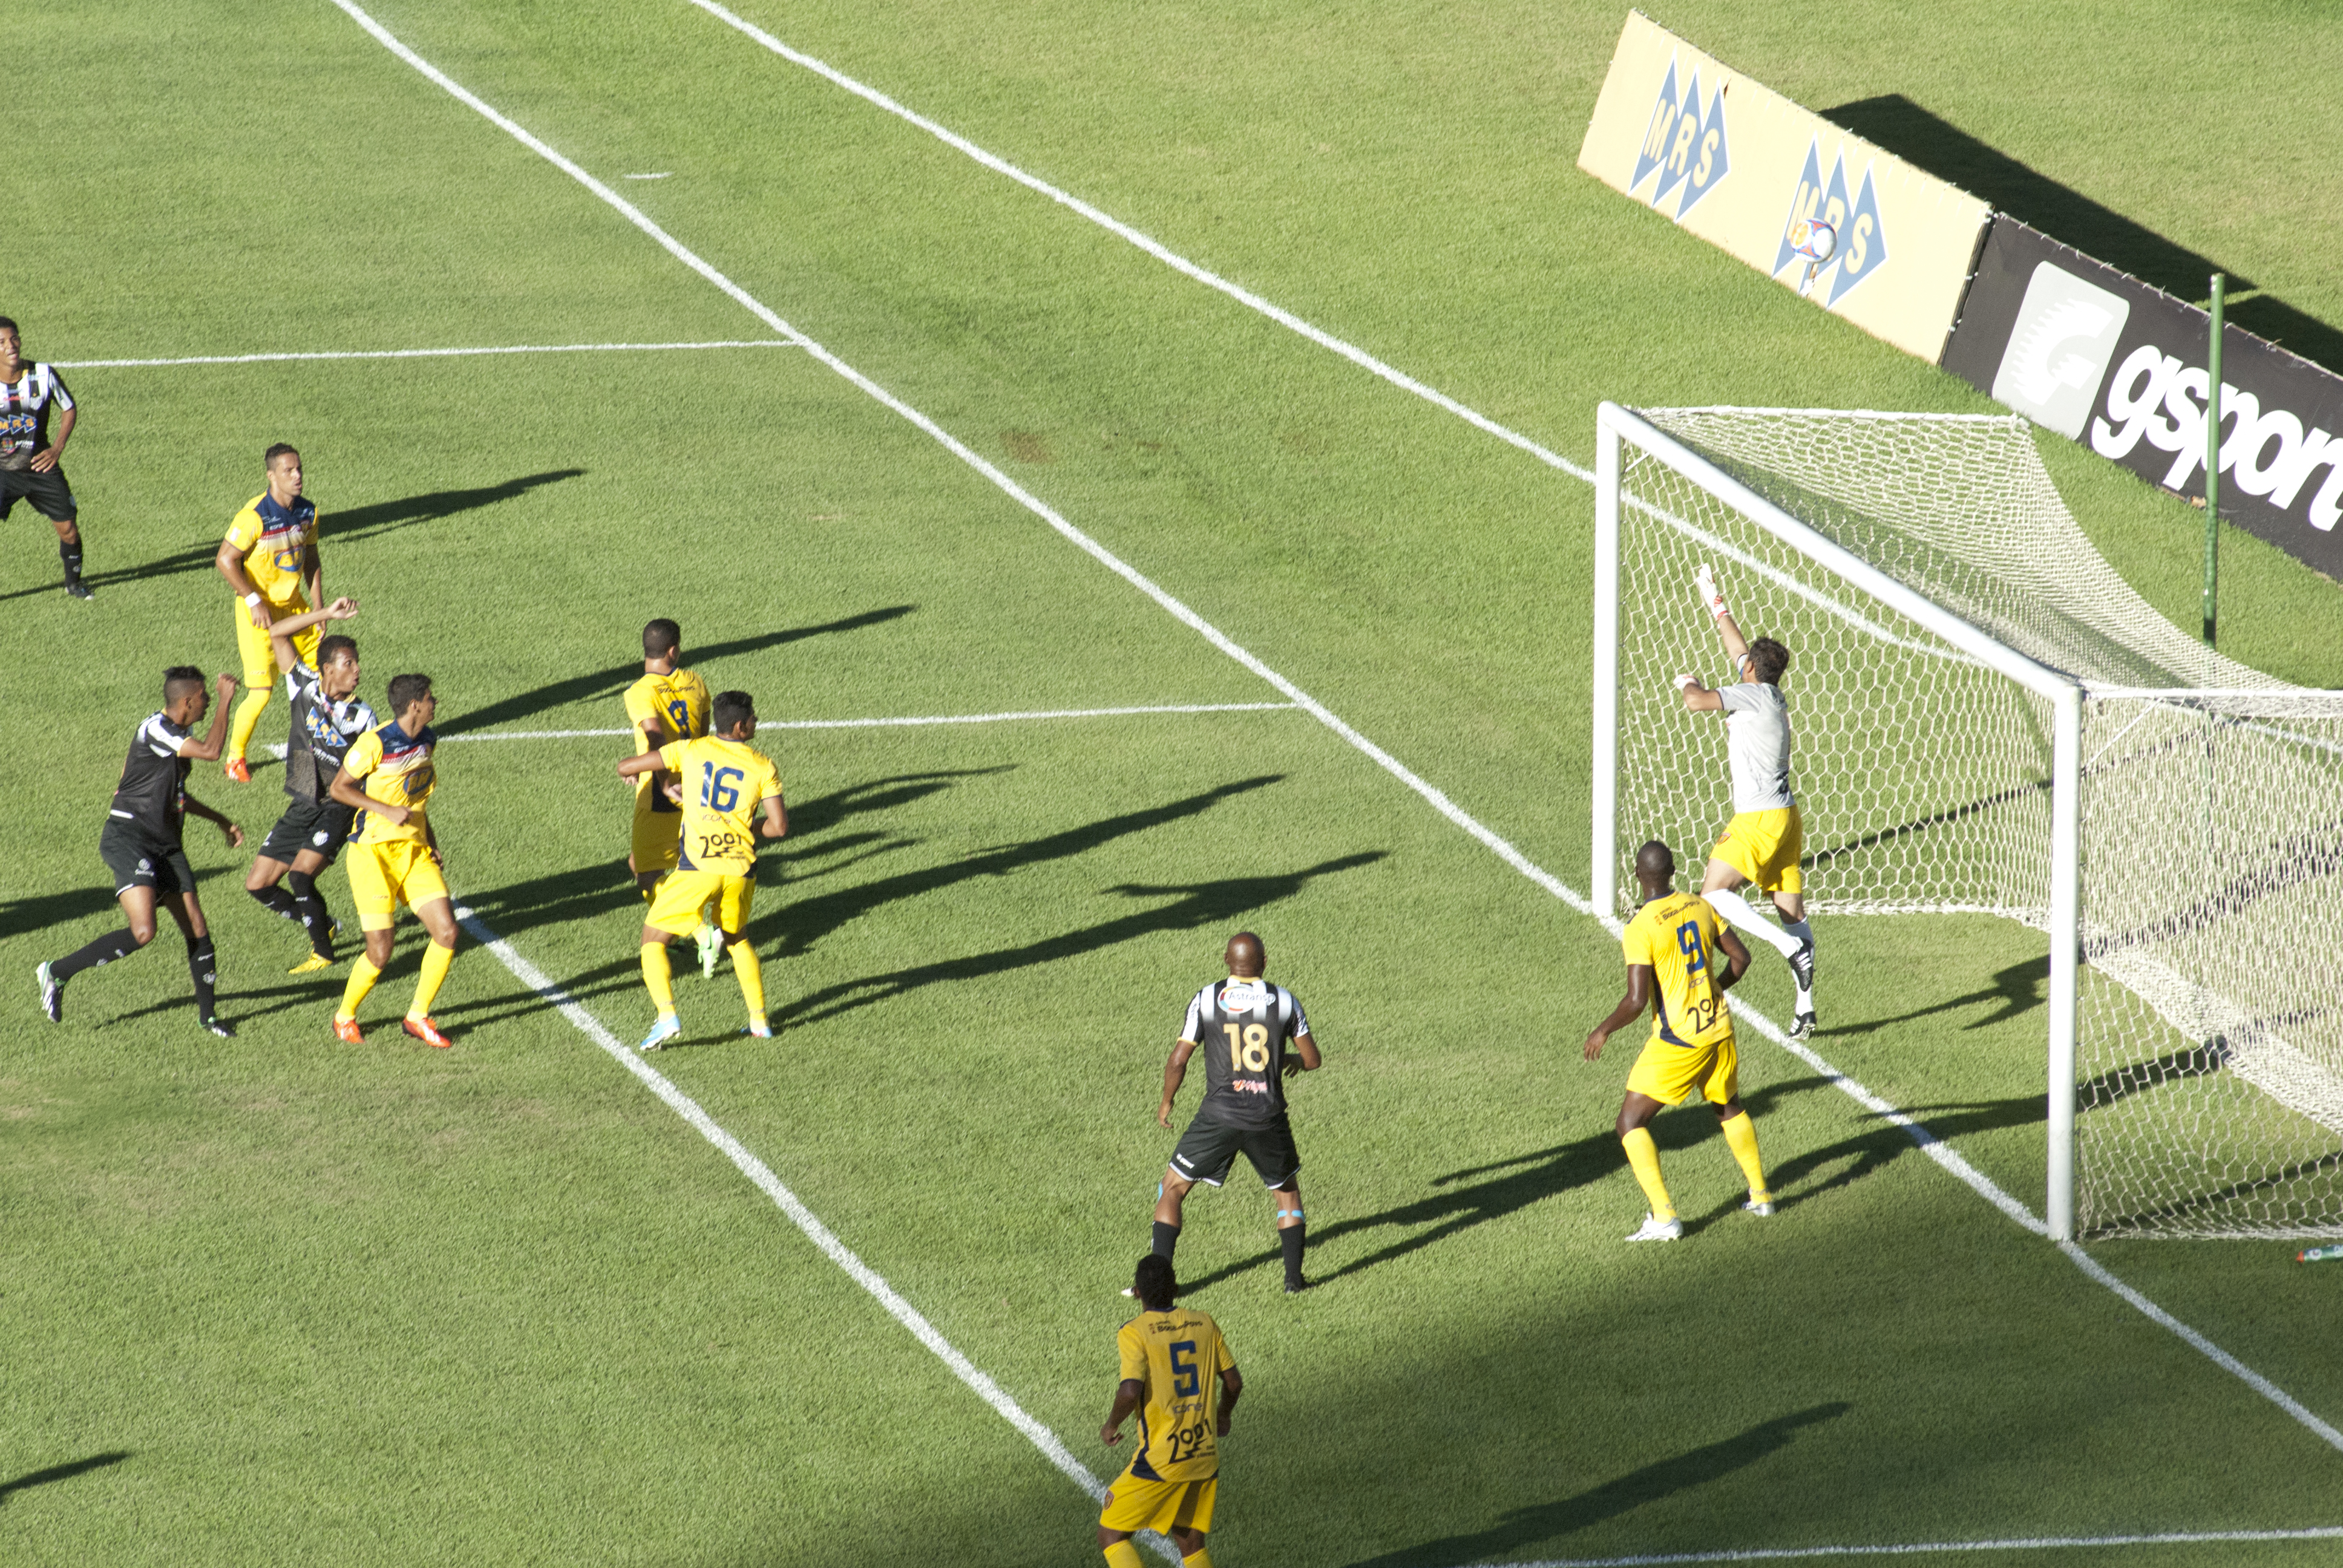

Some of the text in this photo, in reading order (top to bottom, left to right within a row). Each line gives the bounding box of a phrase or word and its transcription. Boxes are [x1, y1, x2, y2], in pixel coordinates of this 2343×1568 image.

[1643, 98, 1720, 188] MRS
[700, 760, 745, 813] 16
[699, 832, 742, 860] 2001
[1677, 920, 1705, 975] 9
[1229, 991, 1276, 1005] Astransp
[1224, 1023, 1270, 1072] 18
[1169, 1339, 1200, 1399] 5
[1167, 1418, 1213, 1465] 2001
